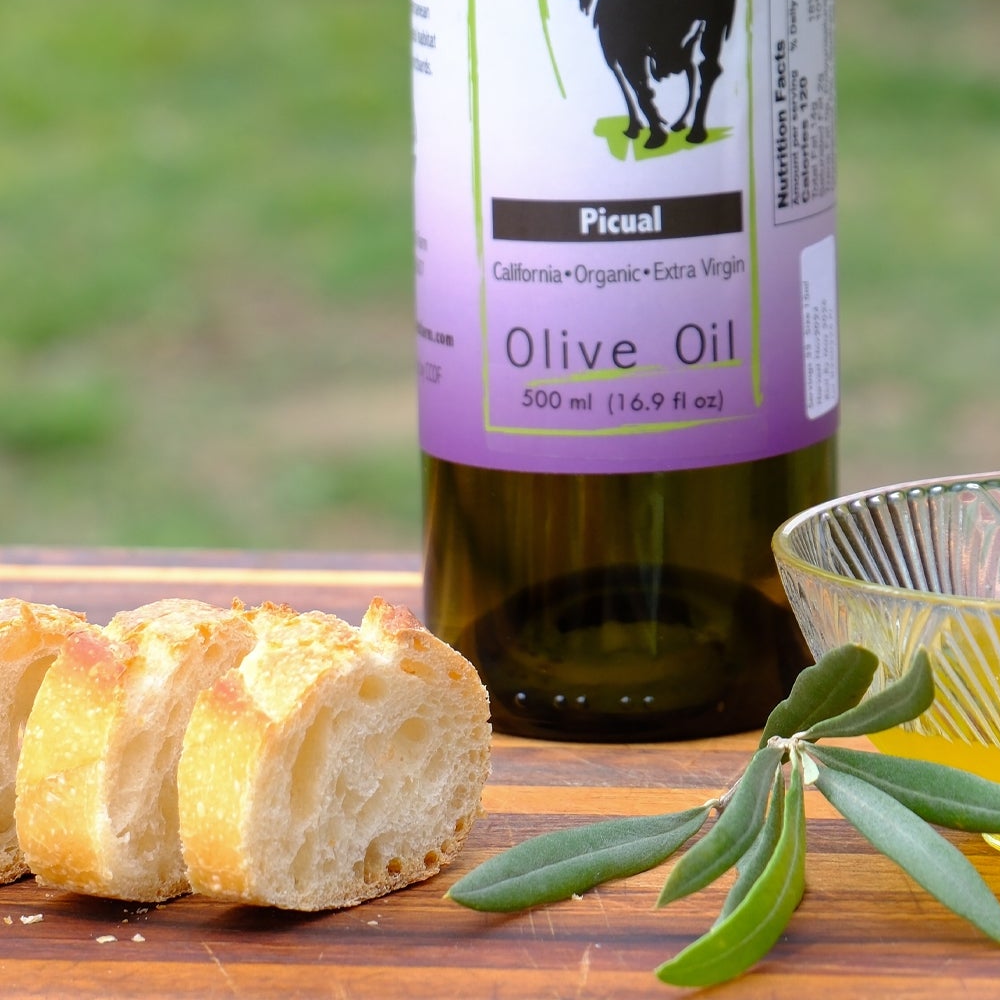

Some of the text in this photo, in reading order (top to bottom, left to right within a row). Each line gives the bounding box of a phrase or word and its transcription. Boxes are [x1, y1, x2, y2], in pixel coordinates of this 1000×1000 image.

[789, 0, 799, 35] Daily
[774, 38, 789, 209] Nutrition Facts
[790, 70, 800, 205] Amount per serving
[799, 76, 810, 204] Calories 120
[579, 204, 662, 236] Picual
[493, 255, 745, 288] California Organic Extra Virgin
[506, 319, 735, 369] Olive Oil
[522, 389, 724, 415] 500 ml (16.9 fl oz)
